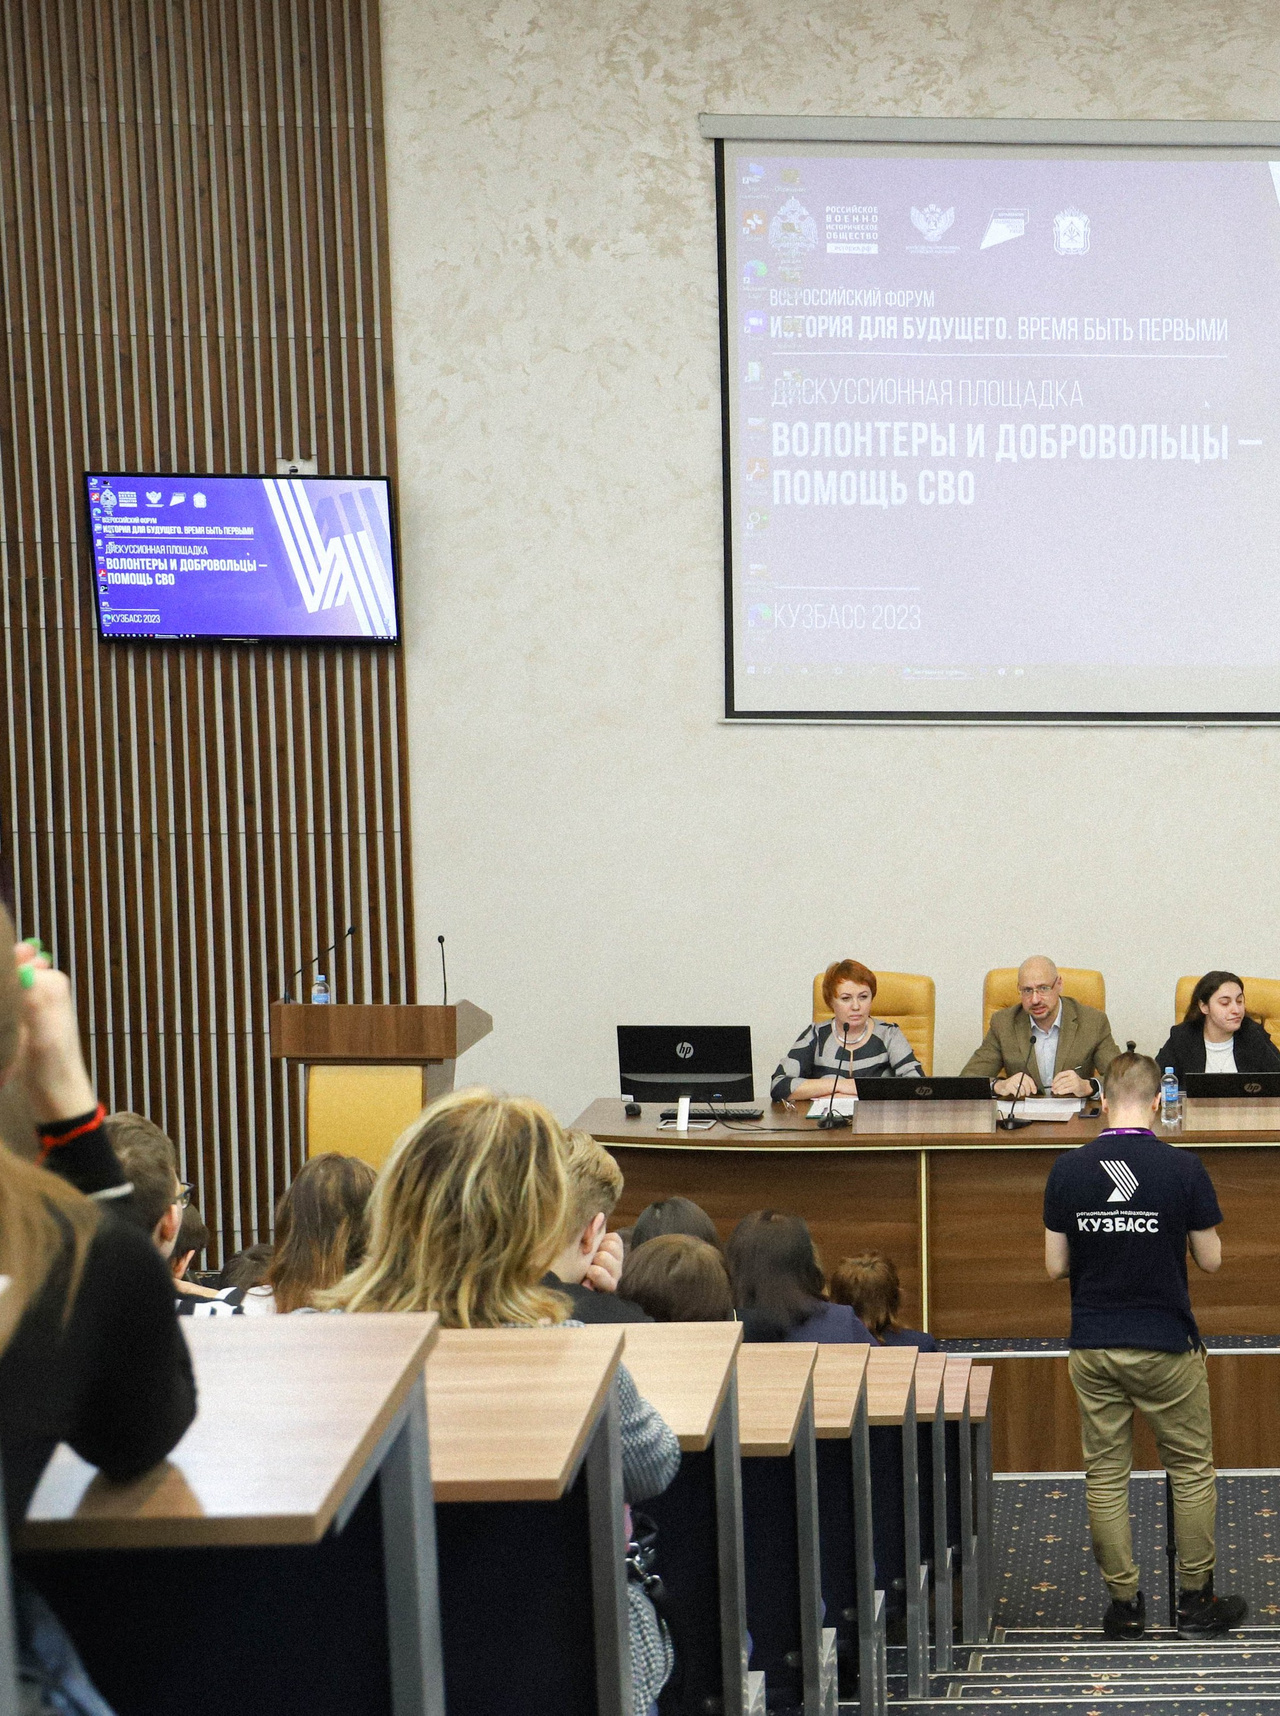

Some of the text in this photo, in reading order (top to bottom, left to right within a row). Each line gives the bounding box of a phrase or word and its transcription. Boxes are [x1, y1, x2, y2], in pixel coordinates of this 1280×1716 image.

[826, 205, 878, 214] РОССИЙСКОЕ
[826, 214, 878, 223] ВОЕННО
[826, 232, 878, 241] ОБЩЕСТВО
[885, 289, 935, 308] ФОРУМ
[858, 316, 898, 341] ДЛЯ
[903, 316, 1012, 342] БУДУЩЕГО.
[1018, 316, 1078, 340] ВРЕМЯ
[1084, 317, 1134, 341] БЫТЬ
[1139, 318, 1228, 342] ПЕРВЫМИ
[958, 379, 1084, 410] ПЛОЩАДКА
[772, 421, 956, 458] ВОЛОНТЕРЫ
[966, 423, 986, 459] И
[995, 423, 1229, 465] ДОБРОВОЛЬЦЫ
[772, 469, 975, 510] ПОМОЩЬ СВО
[102, 525, 132, 534] ИТОРИЯ
[184, 526, 205, 535] ВРЕМЯ
[205, 526, 223, 535] БЫТЬ
[166, 545, 209, 556] ПЛОЩАДКА
[106, 557, 168, 571] ВОЛОНТЕРЫ
[169, 558, 178, 571] И
[179, 558, 257, 573] ДОБРОВОЛЬЦЫ
[107, 572, 176, 587] ПОМОЩЬ СВО
[111, 614, 161, 624] КУЗБАСС 2023
[774, 602, 921, 630] КУЗБАСС 2023
[679, 1042, 692, 1058] hp
[1077, 1217, 1159, 1233] КУЗБАСС
